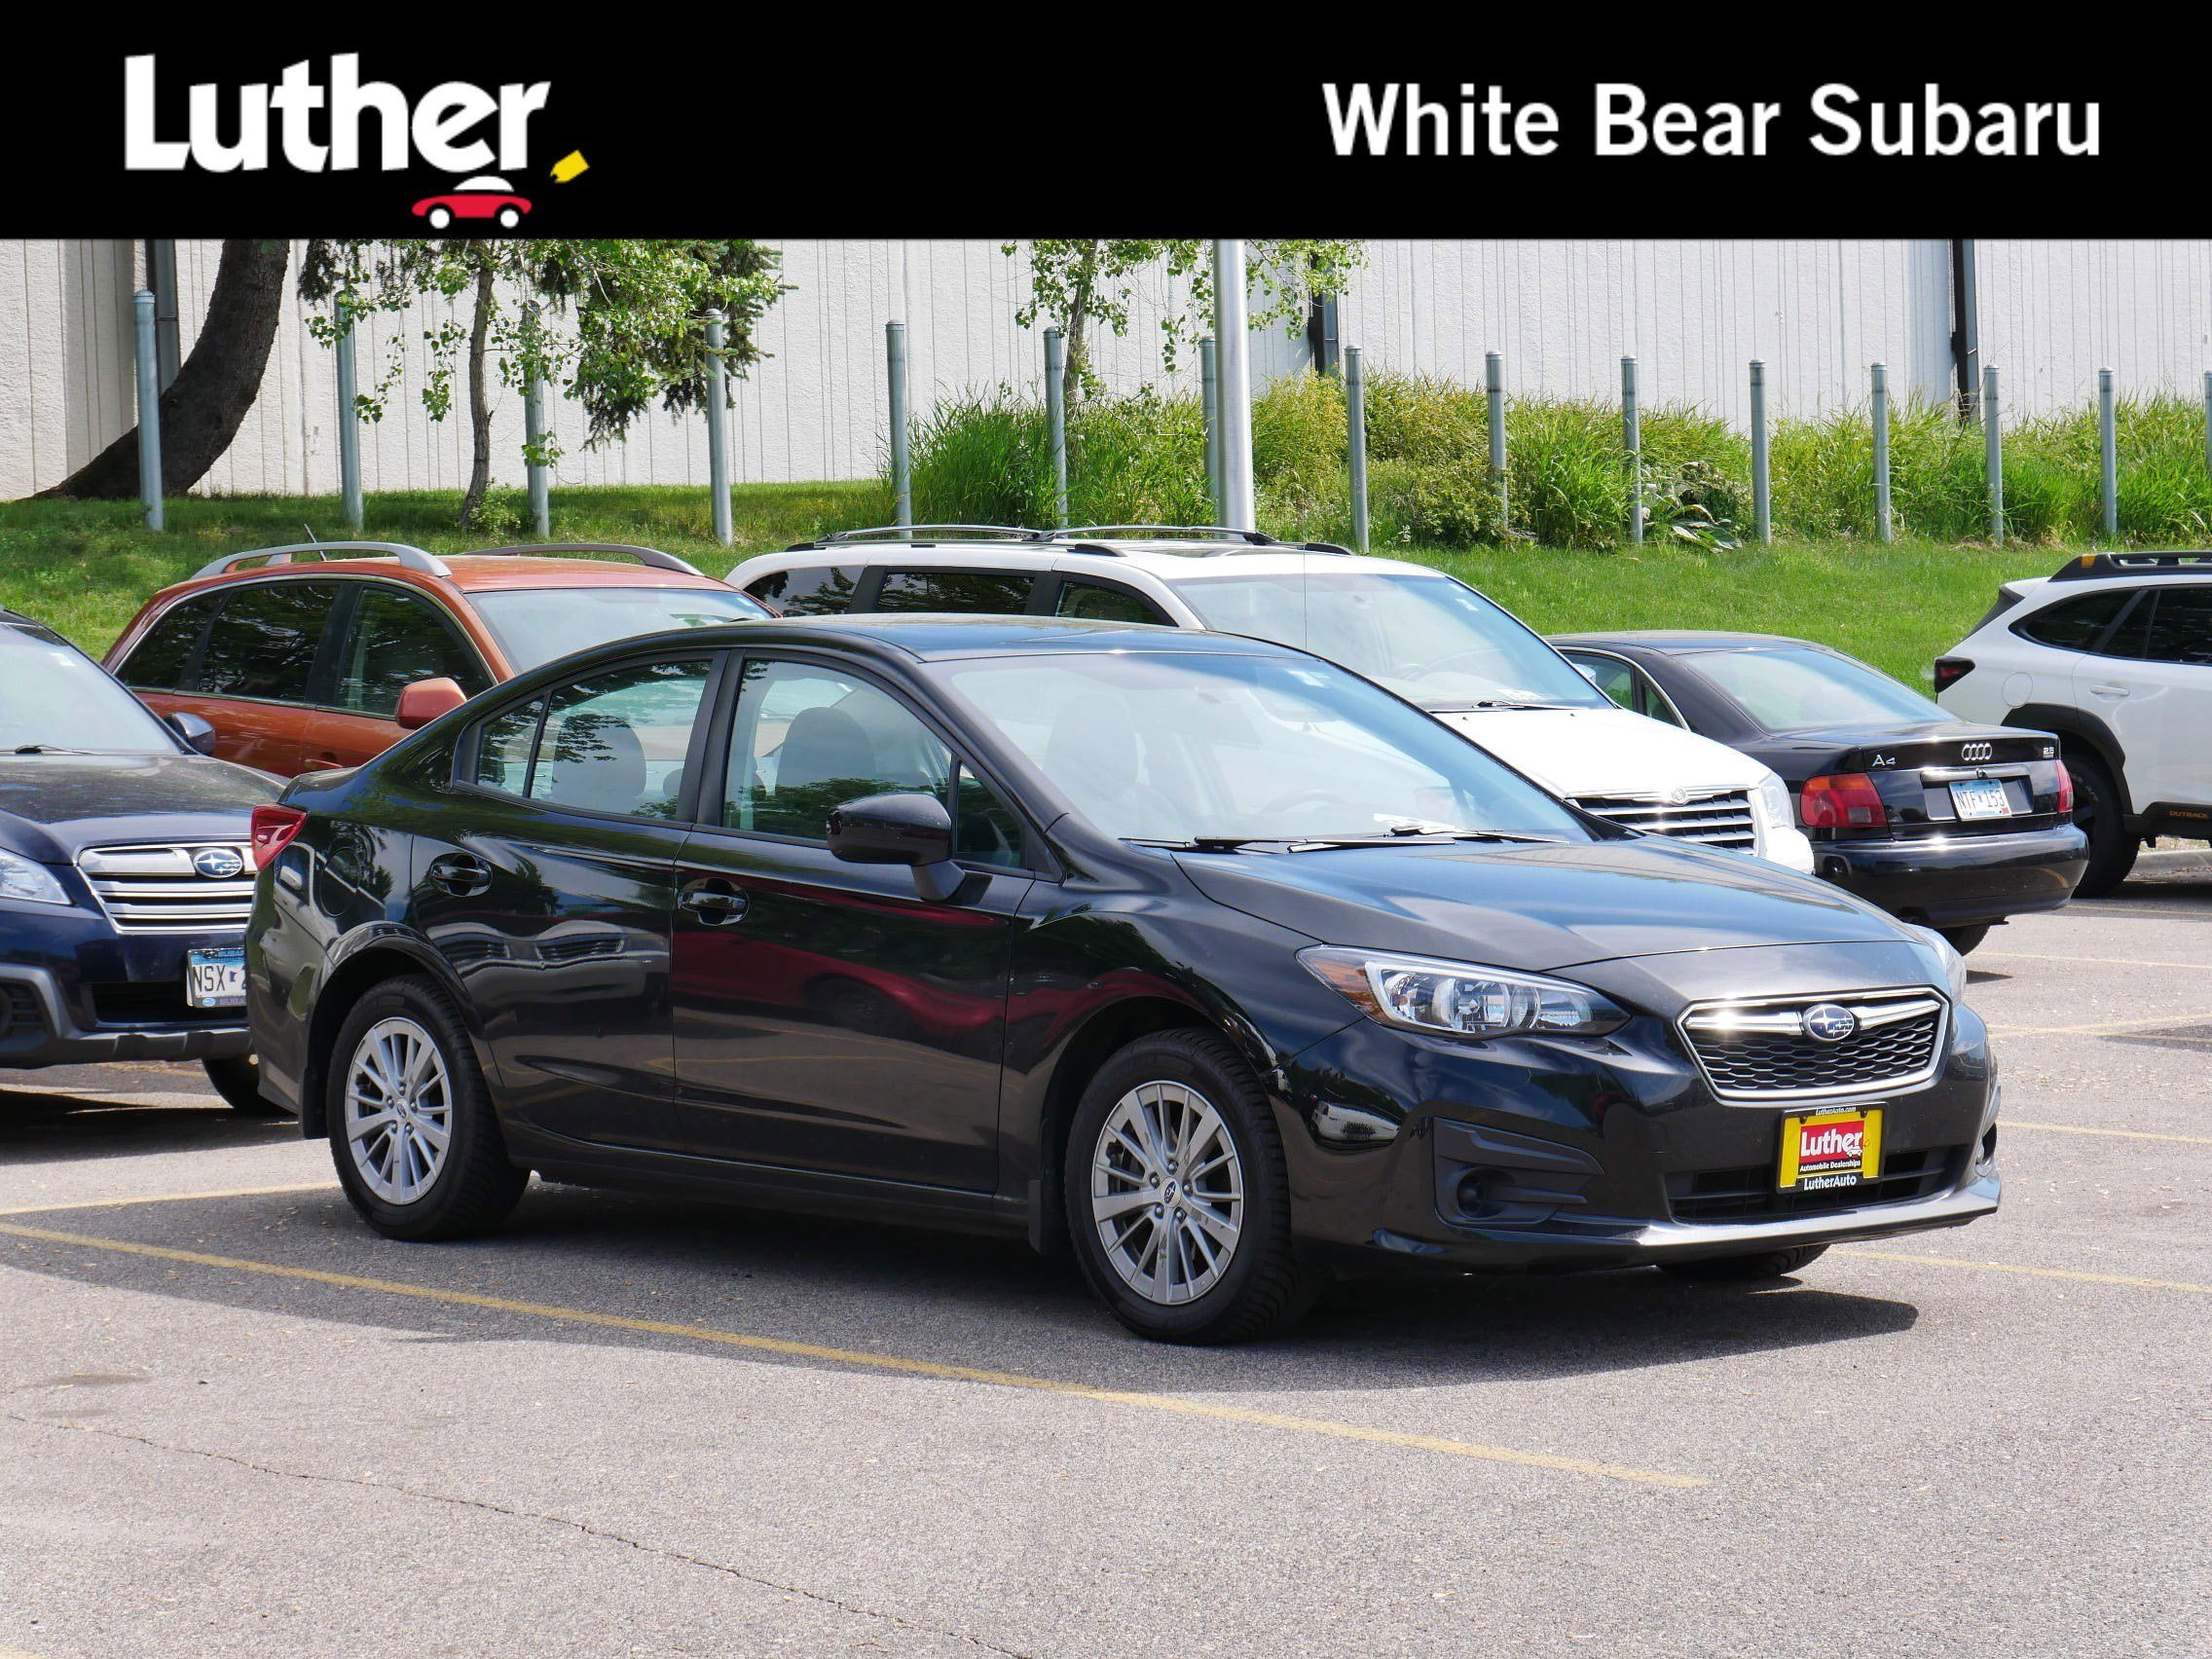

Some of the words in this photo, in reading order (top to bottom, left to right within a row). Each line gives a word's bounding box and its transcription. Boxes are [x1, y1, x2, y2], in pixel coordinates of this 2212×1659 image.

[1872, 754, 1897, 767] A4
[194, 965, 226, 992] NSX
[1800, 1128, 1863, 1158] Luther
[1799, 1161, 1830, 1172] Automobile
[1829, 1160, 1862, 1169] Dealerships
[1803, 1175, 1858, 1191] LutherAuto
